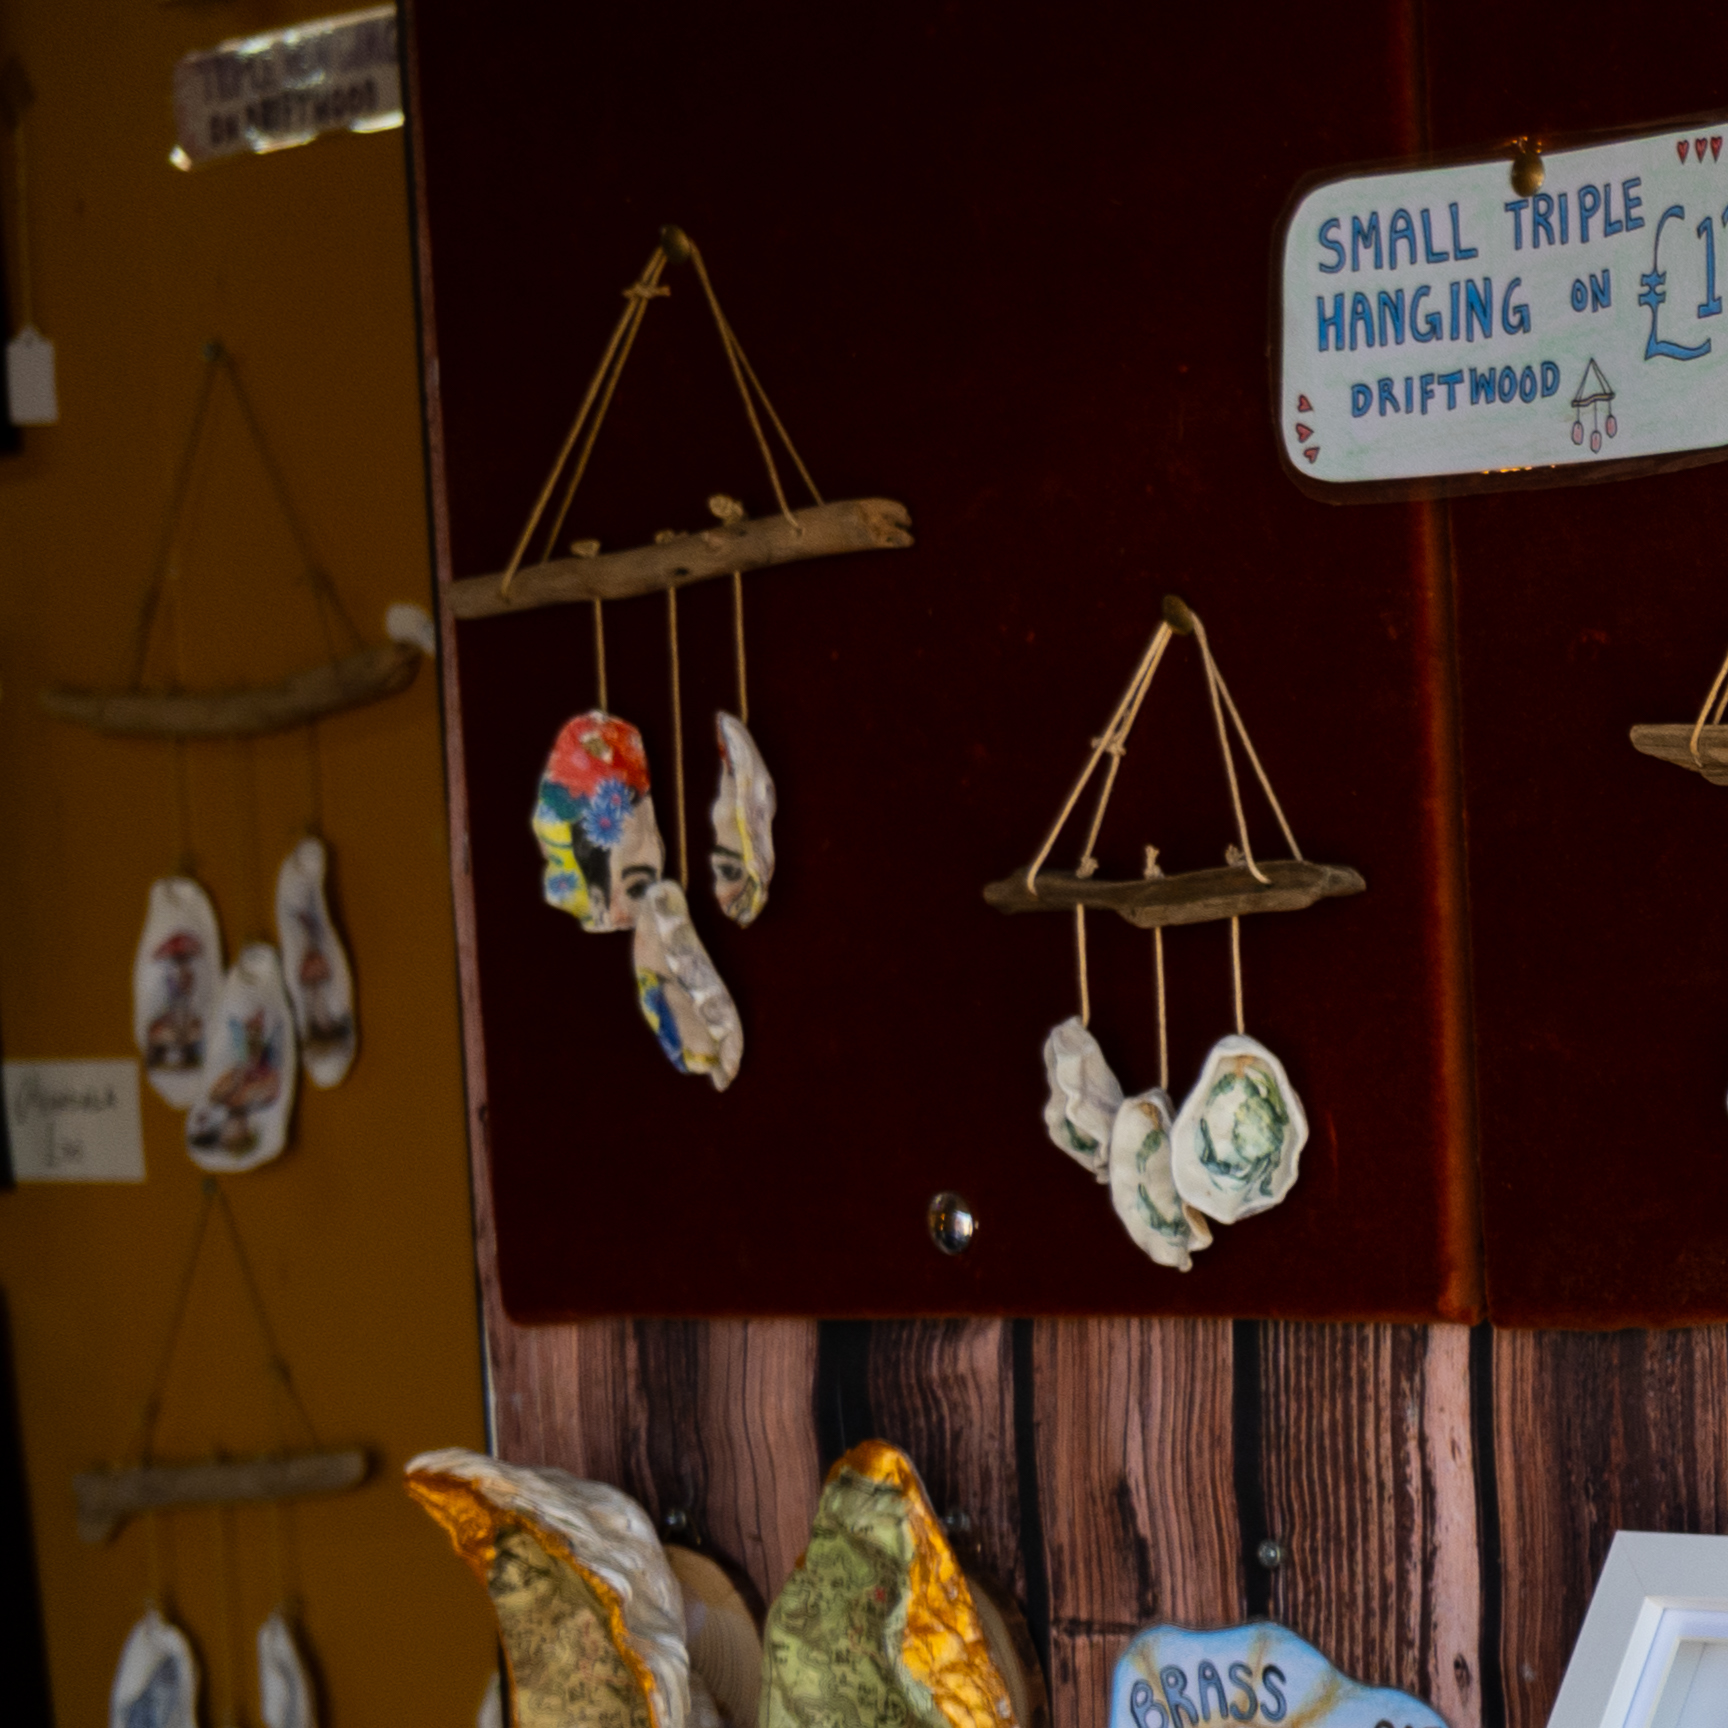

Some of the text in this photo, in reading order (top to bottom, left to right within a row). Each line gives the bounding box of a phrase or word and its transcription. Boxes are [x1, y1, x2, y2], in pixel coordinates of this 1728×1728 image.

[1318, 177, 1646, 274] SMALL TRIPLE
[1317, 269, 1612, 353] HANGING ON
[1350, 360, 1561, 418] DRIFTWOOD
